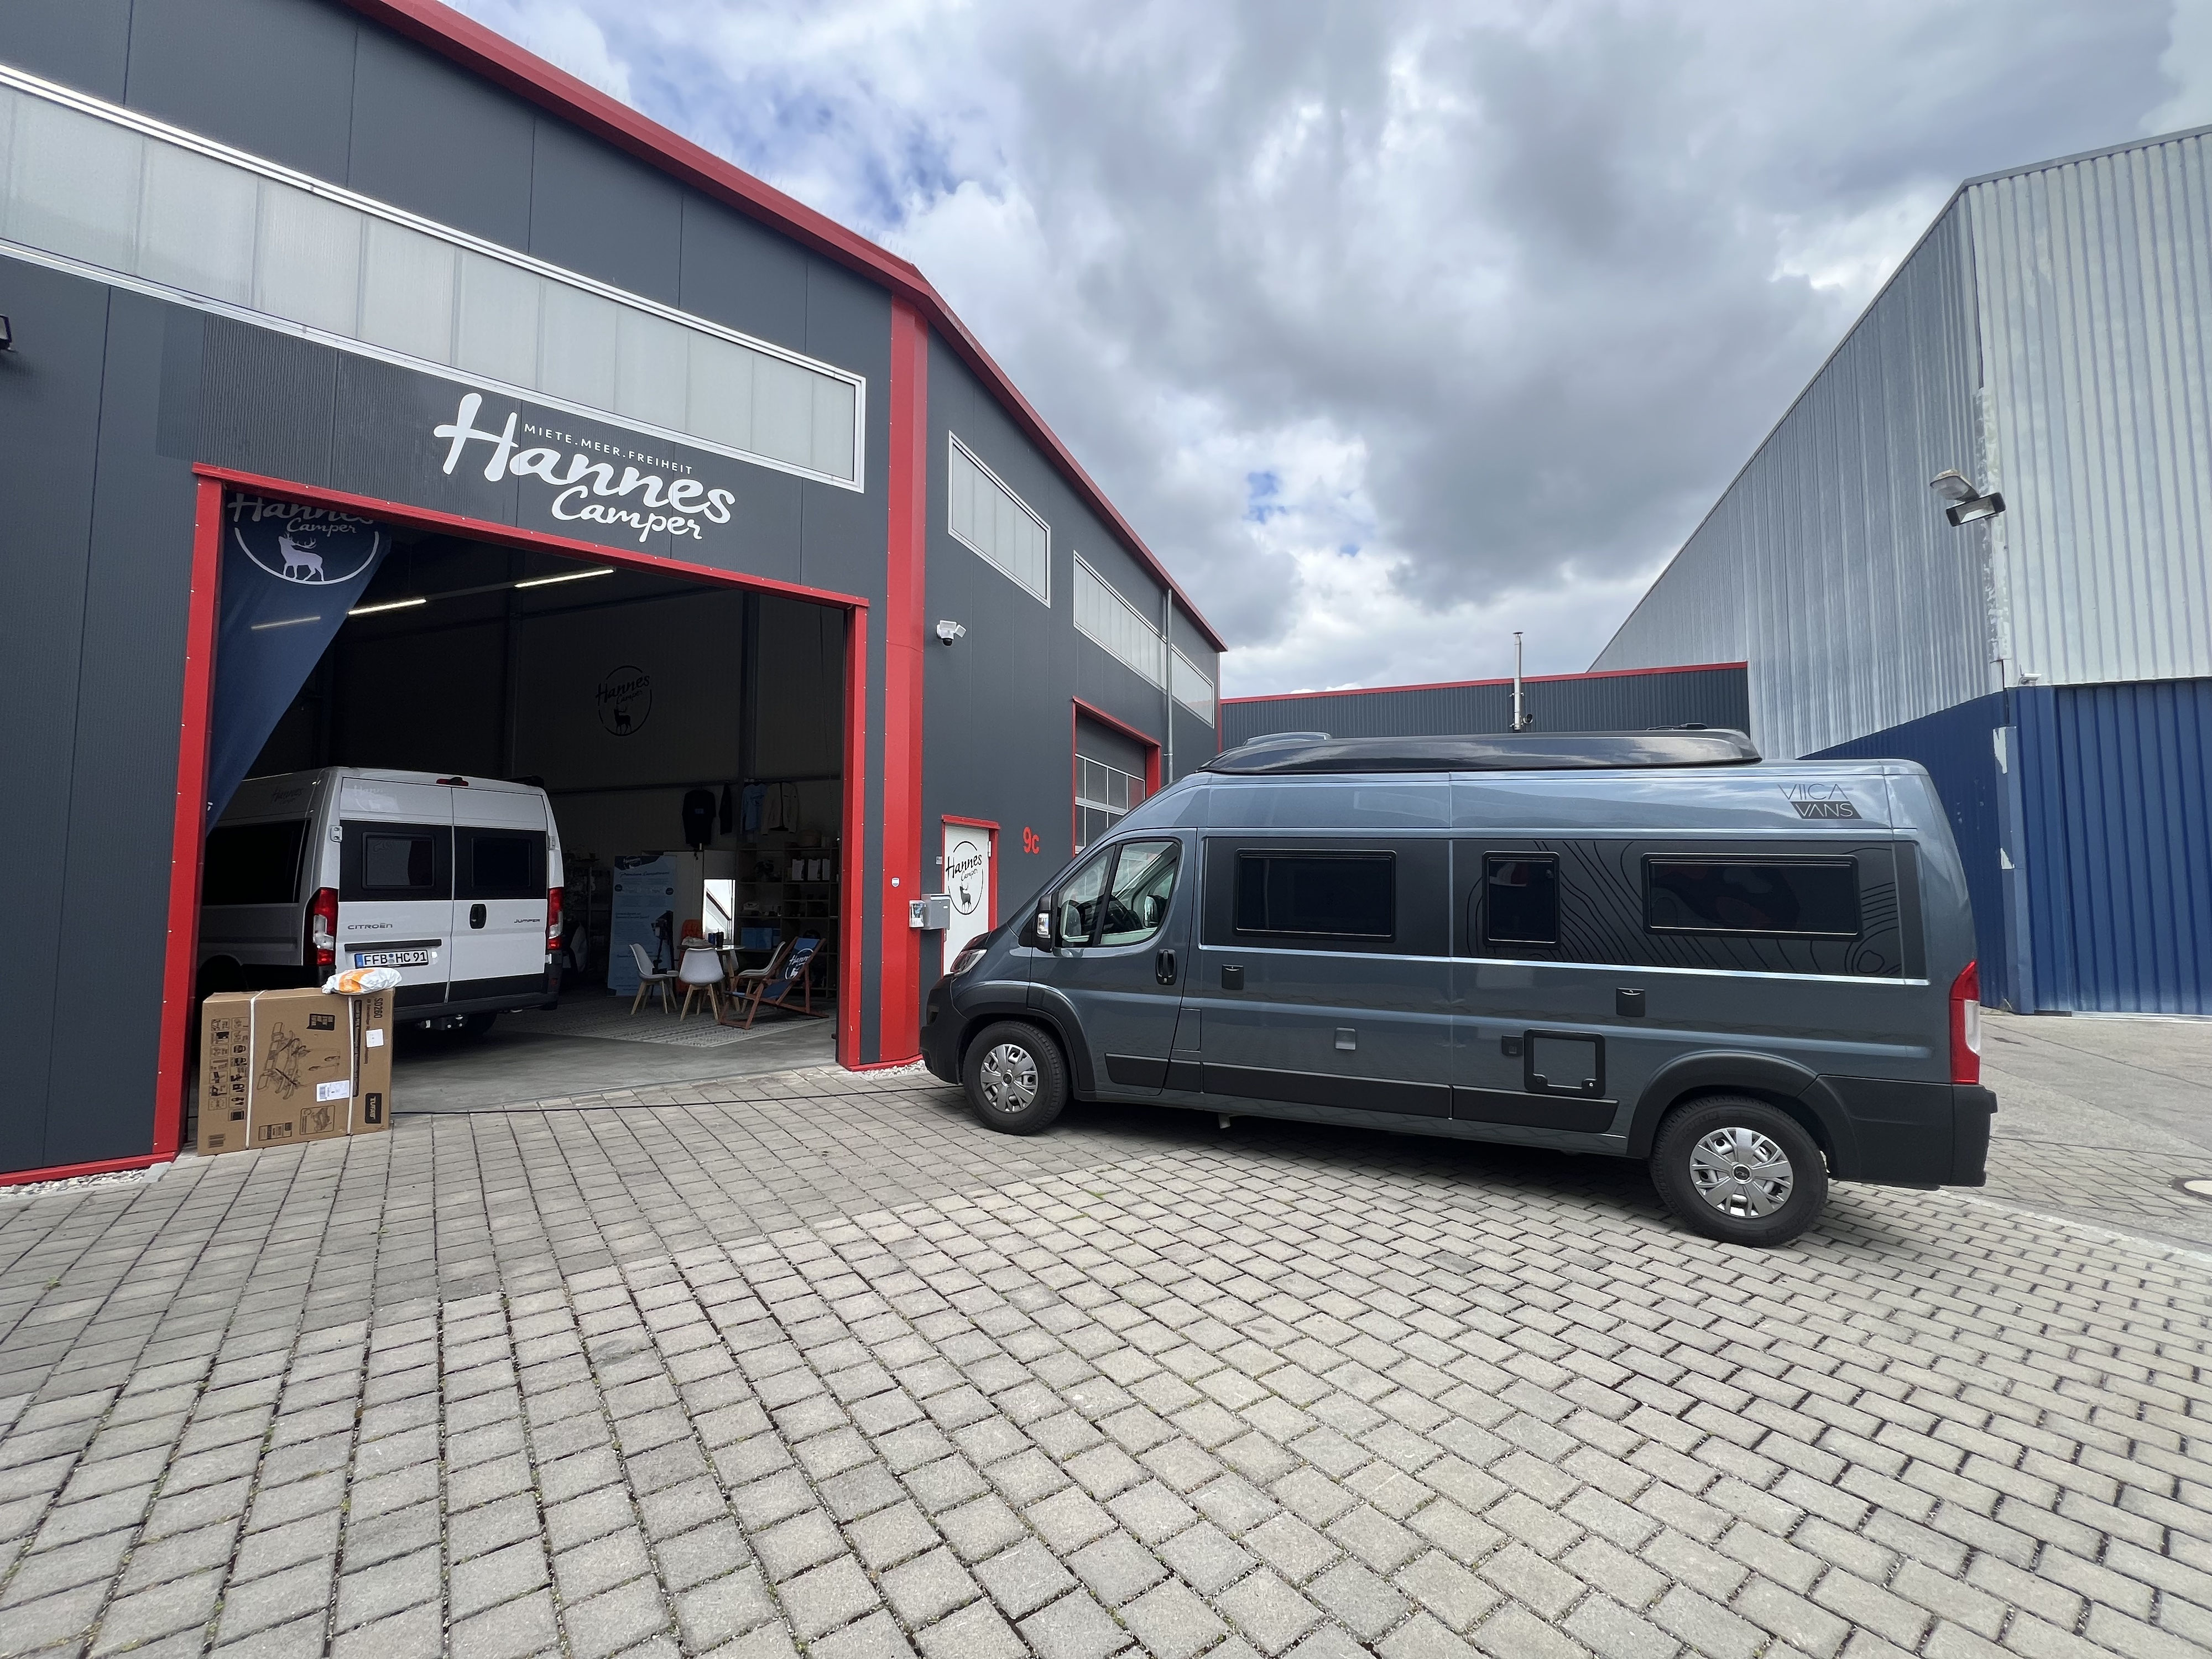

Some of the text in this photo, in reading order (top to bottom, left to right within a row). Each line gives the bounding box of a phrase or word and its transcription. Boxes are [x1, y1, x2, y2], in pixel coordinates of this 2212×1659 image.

[434, 393, 735, 524] Hannes
[552, 486, 702, 542] Camper
[286, 518, 357, 537] Camper
[596, 675, 650, 706] Hannes
[1795, 803, 1853, 817] VANS
[1023, 826, 1040, 854] 9c
[945, 854, 982, 881] Hannes
[364, 951, 427, 966] FFB HC 91
[789, 954, 811, 967] Hann
[374, 997, 383, 1019] SD260
